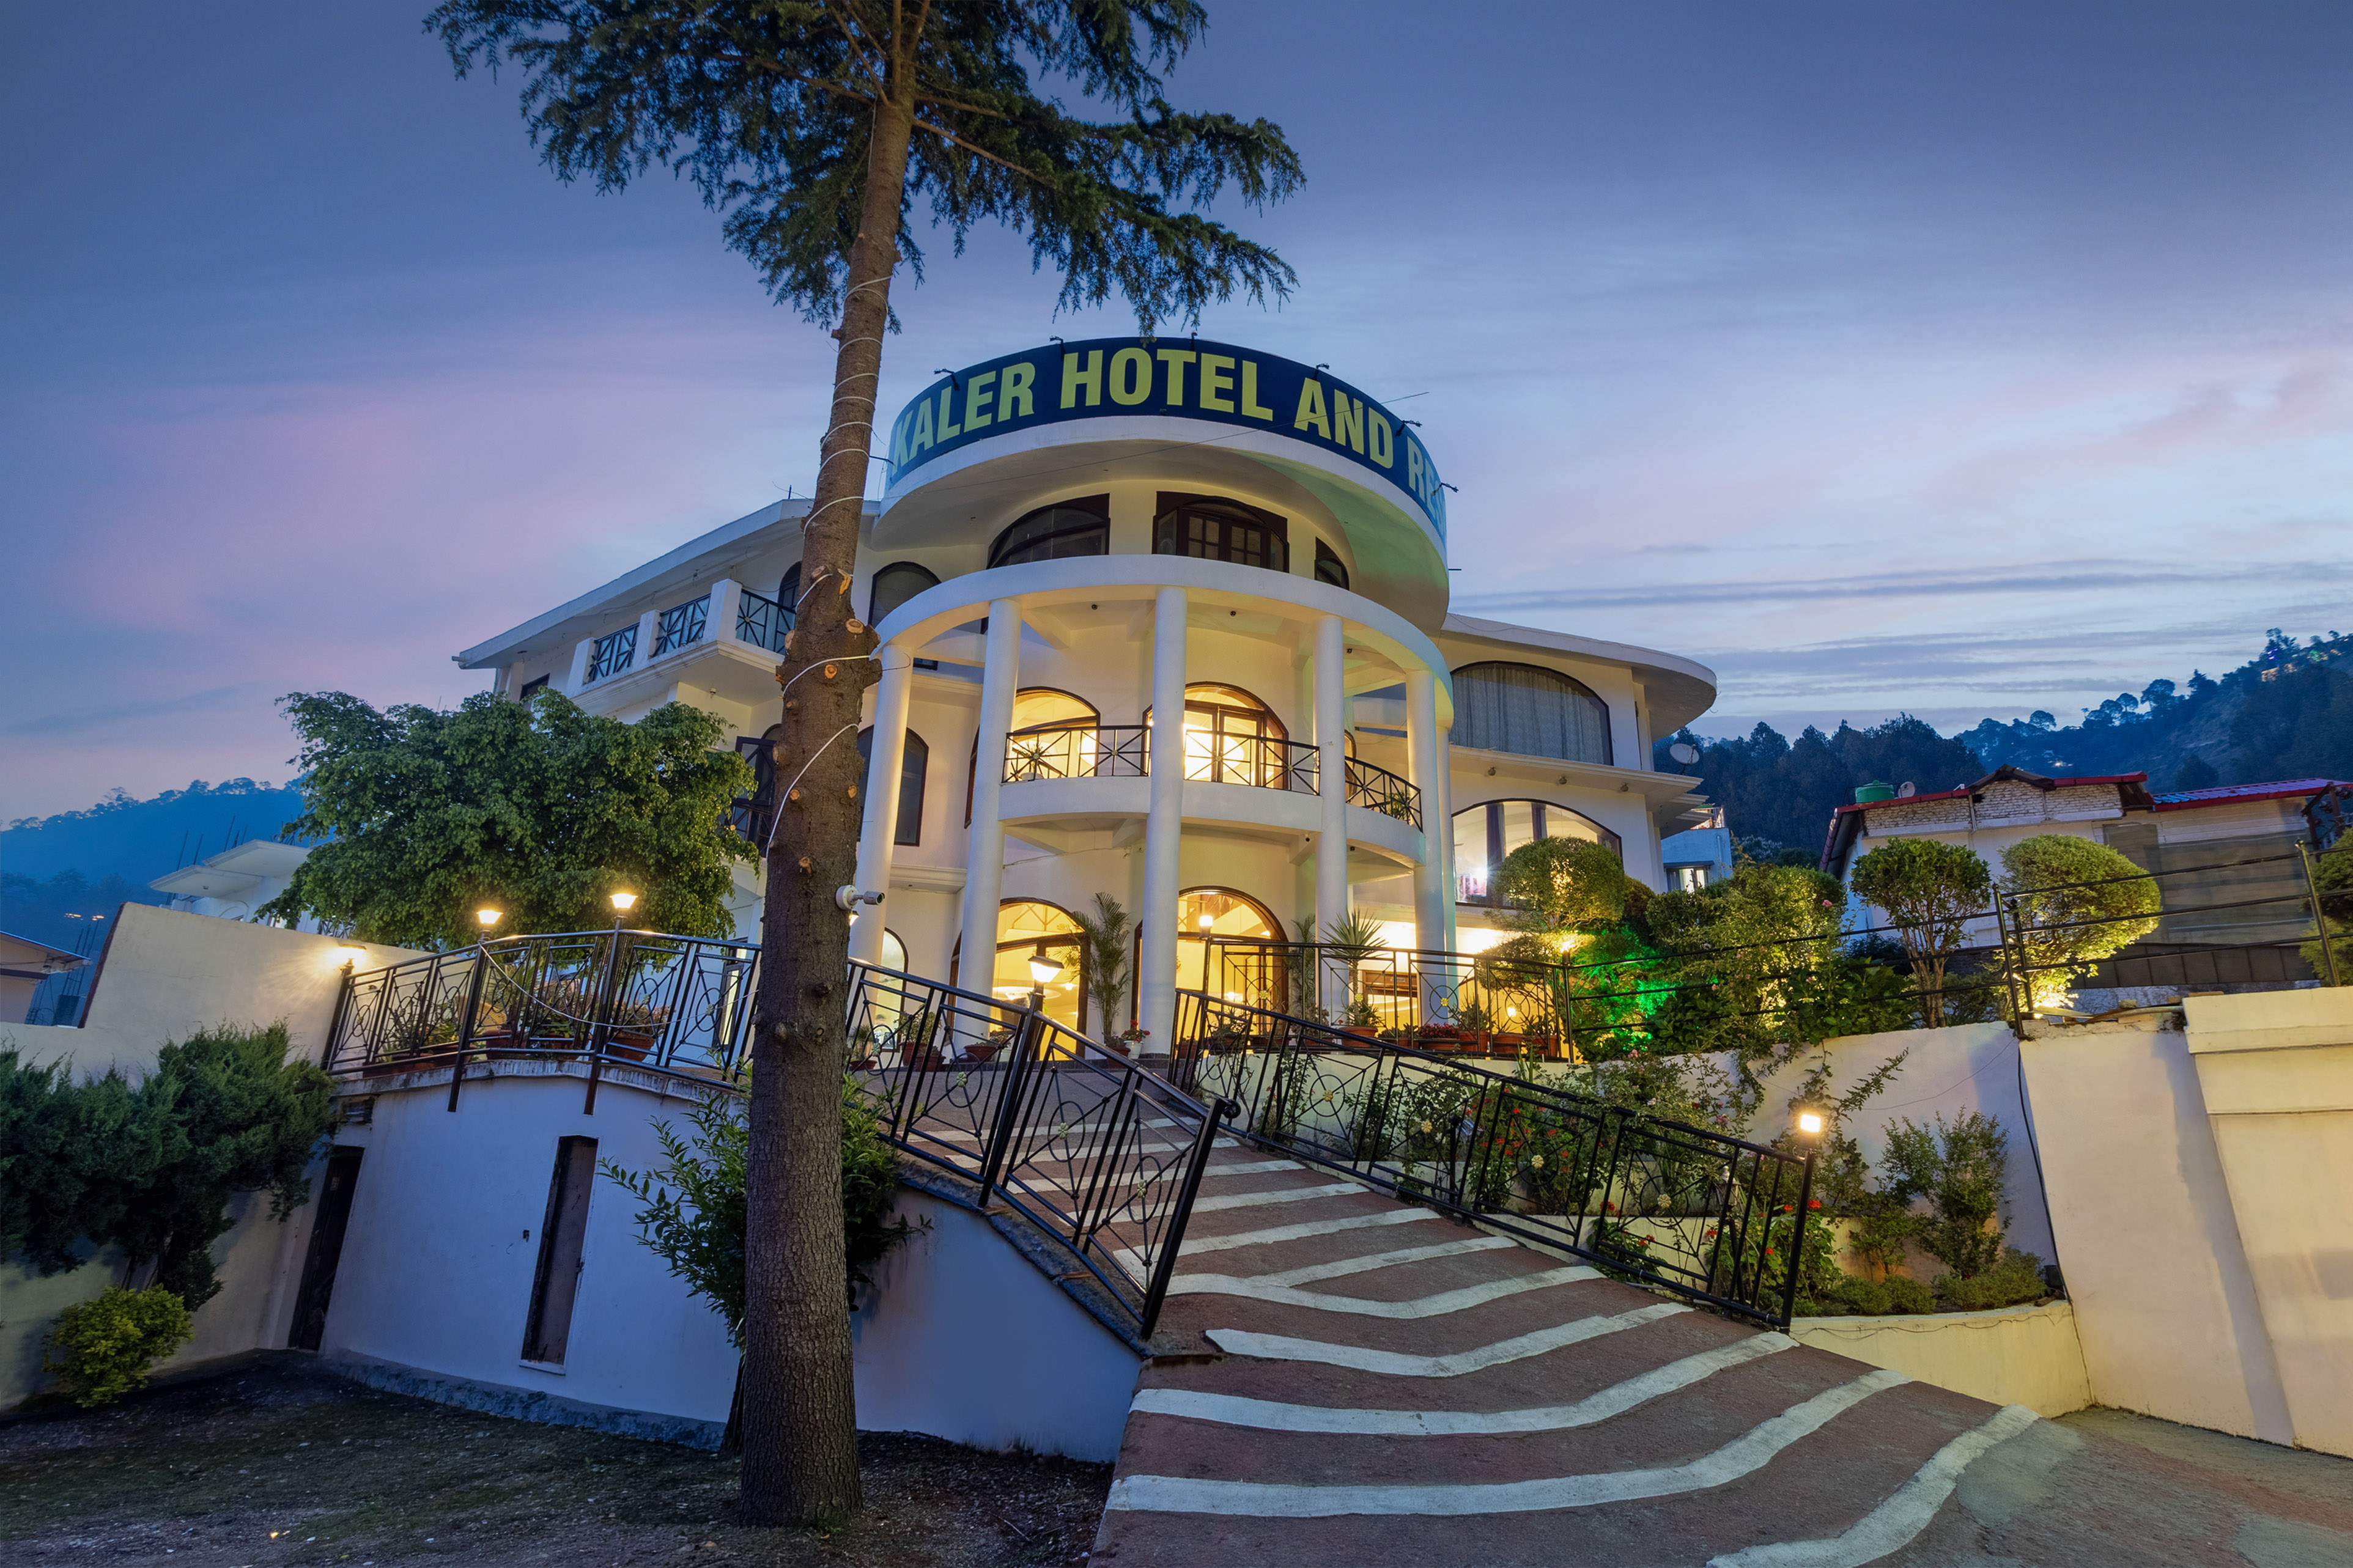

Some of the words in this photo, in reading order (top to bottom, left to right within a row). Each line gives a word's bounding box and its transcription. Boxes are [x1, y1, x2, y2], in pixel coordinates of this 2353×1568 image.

[892, 363, 1035, 477] KALER
[1060, 347, 1273, 422] HOTEL
[1293, 377, 1394, 469] AND
